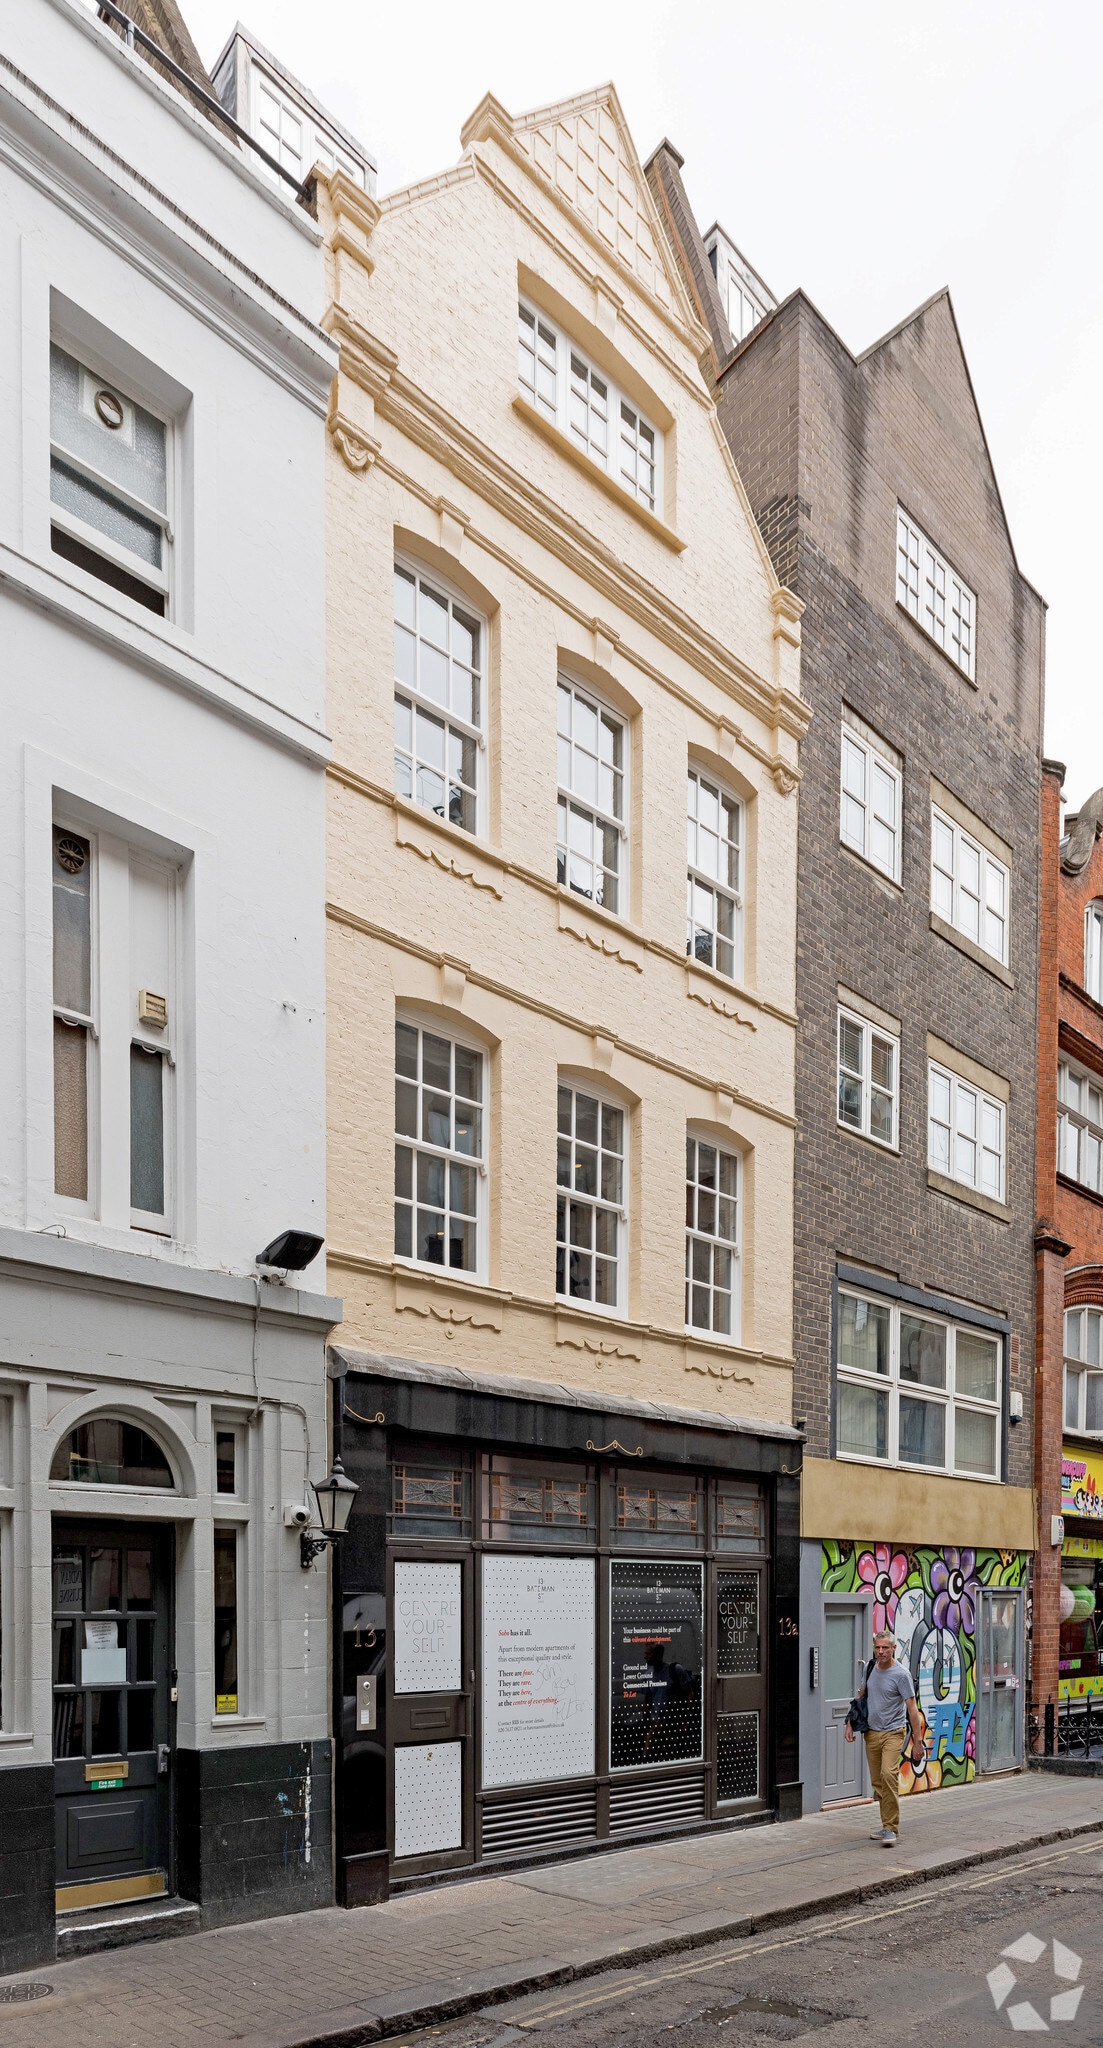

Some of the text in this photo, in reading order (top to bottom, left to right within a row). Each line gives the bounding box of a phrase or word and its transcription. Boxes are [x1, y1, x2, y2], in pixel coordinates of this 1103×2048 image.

[1061, 1459, 1087, 1479] WERPUFF
[399, 1600, 457, 1616] CENTRE
[719, 1601, 756, 1615] CENTRE
[402, 1619, 453, 1635] YOUR-
[721, 1616, 753, 1630] YOUR-
[778, 1617, 799, 1636] 13a
[353, 1623, 377, 1648] 13
[623, 1626, 633, 1634] Your
[633, 1626, 651, 1634] business
[668, 1627, 676, 1635] part
[676, 1625, 682, 1633] of
[727, 1630, 749, 1644] SELF
[412, 1637, 445, 1653] SELF
[498, 1643, 576, 1655] Apart from modern apartments of
[508, 1654, 535, 1664] exceptional
[535, 1654, 551, 1663] quality
[561, 1653, 573, 1662] style.
[622, 1662, 648, 1671] Ground and
[521, 1669, 534, 1678] four.
[498, 1680, 511, 1688] They
[622, 1681, 649, 1689] Commercial
[498, 1690, 511, 1698] They
[504, 1699, 512, 1707] the
[527, 1698, 533, 1707] of
[533, 1696, 559, 1706] everything.
